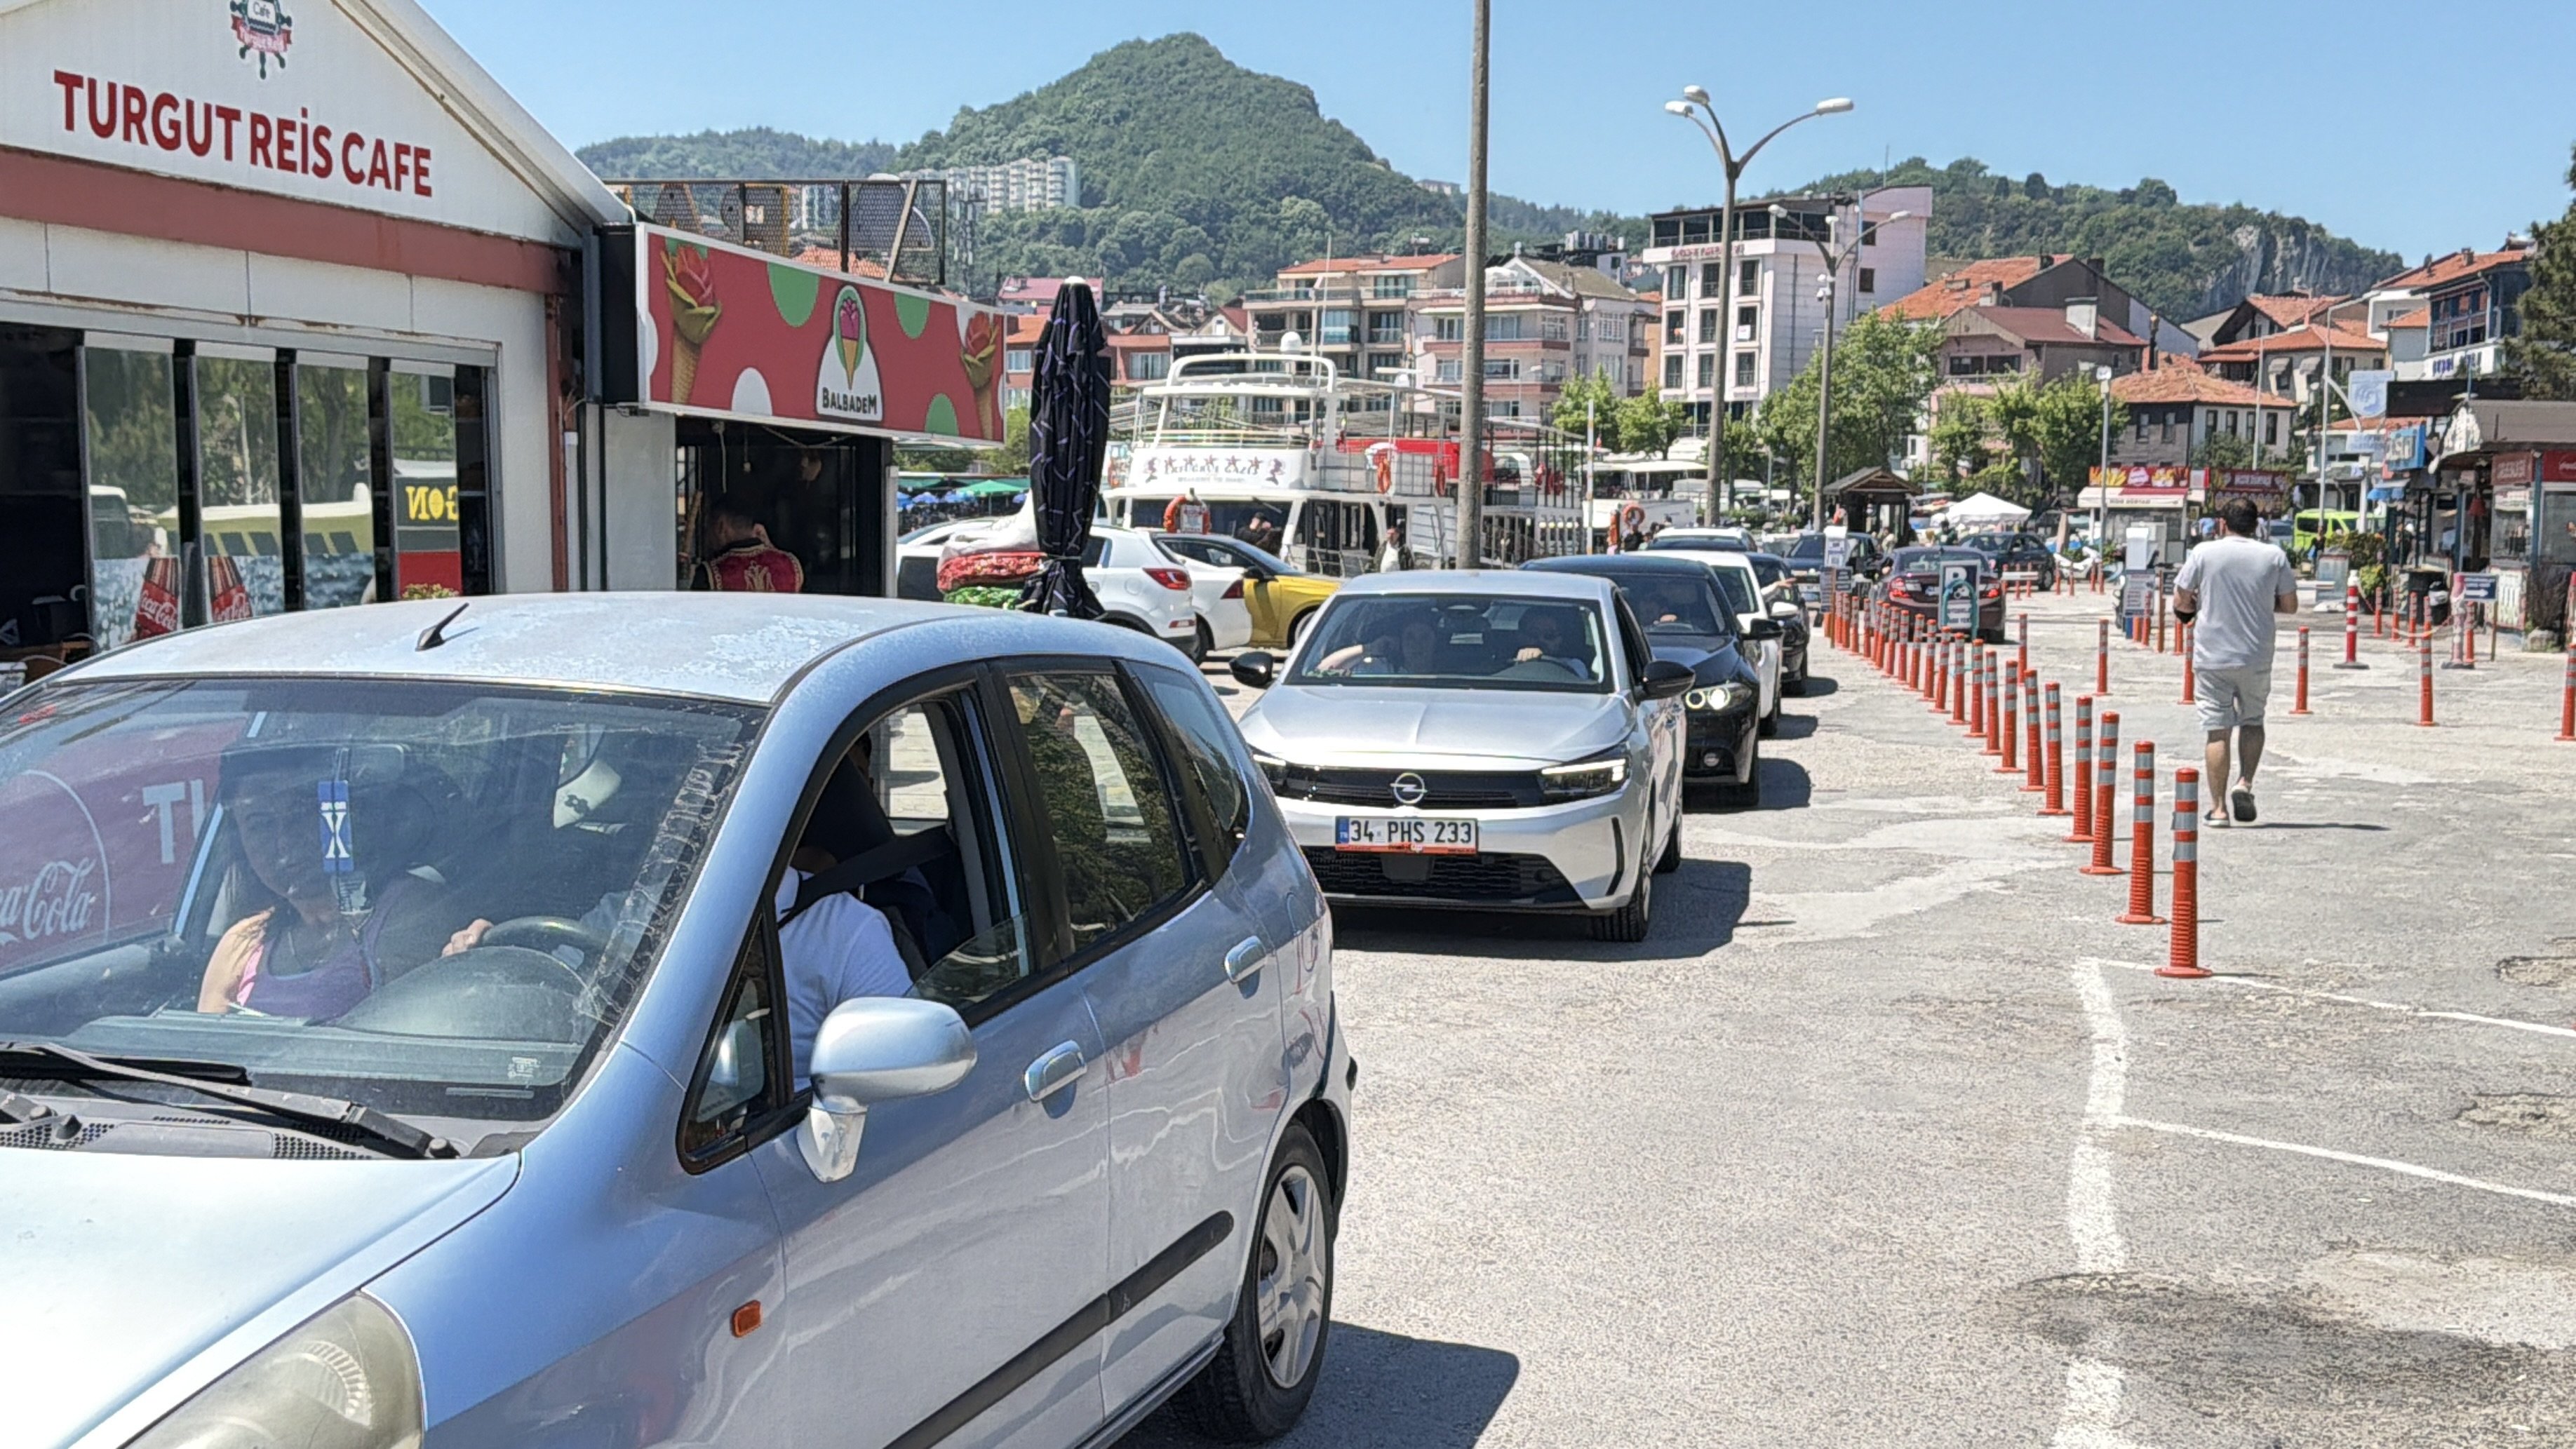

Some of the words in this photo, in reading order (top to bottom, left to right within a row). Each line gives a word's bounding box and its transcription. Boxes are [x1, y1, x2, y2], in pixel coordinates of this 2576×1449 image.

[54, 69, 241, 161] TURGUT
[250, 107, 333, 178] REİS
[342, 132, 432, 197] CAFE
[822, 386, 877, 415] BALBADEM
[1350, 820, 1374, 842] 34
[1387, 821, 1425, 843] PHS
[1434, 821, 1472, 844] 233
